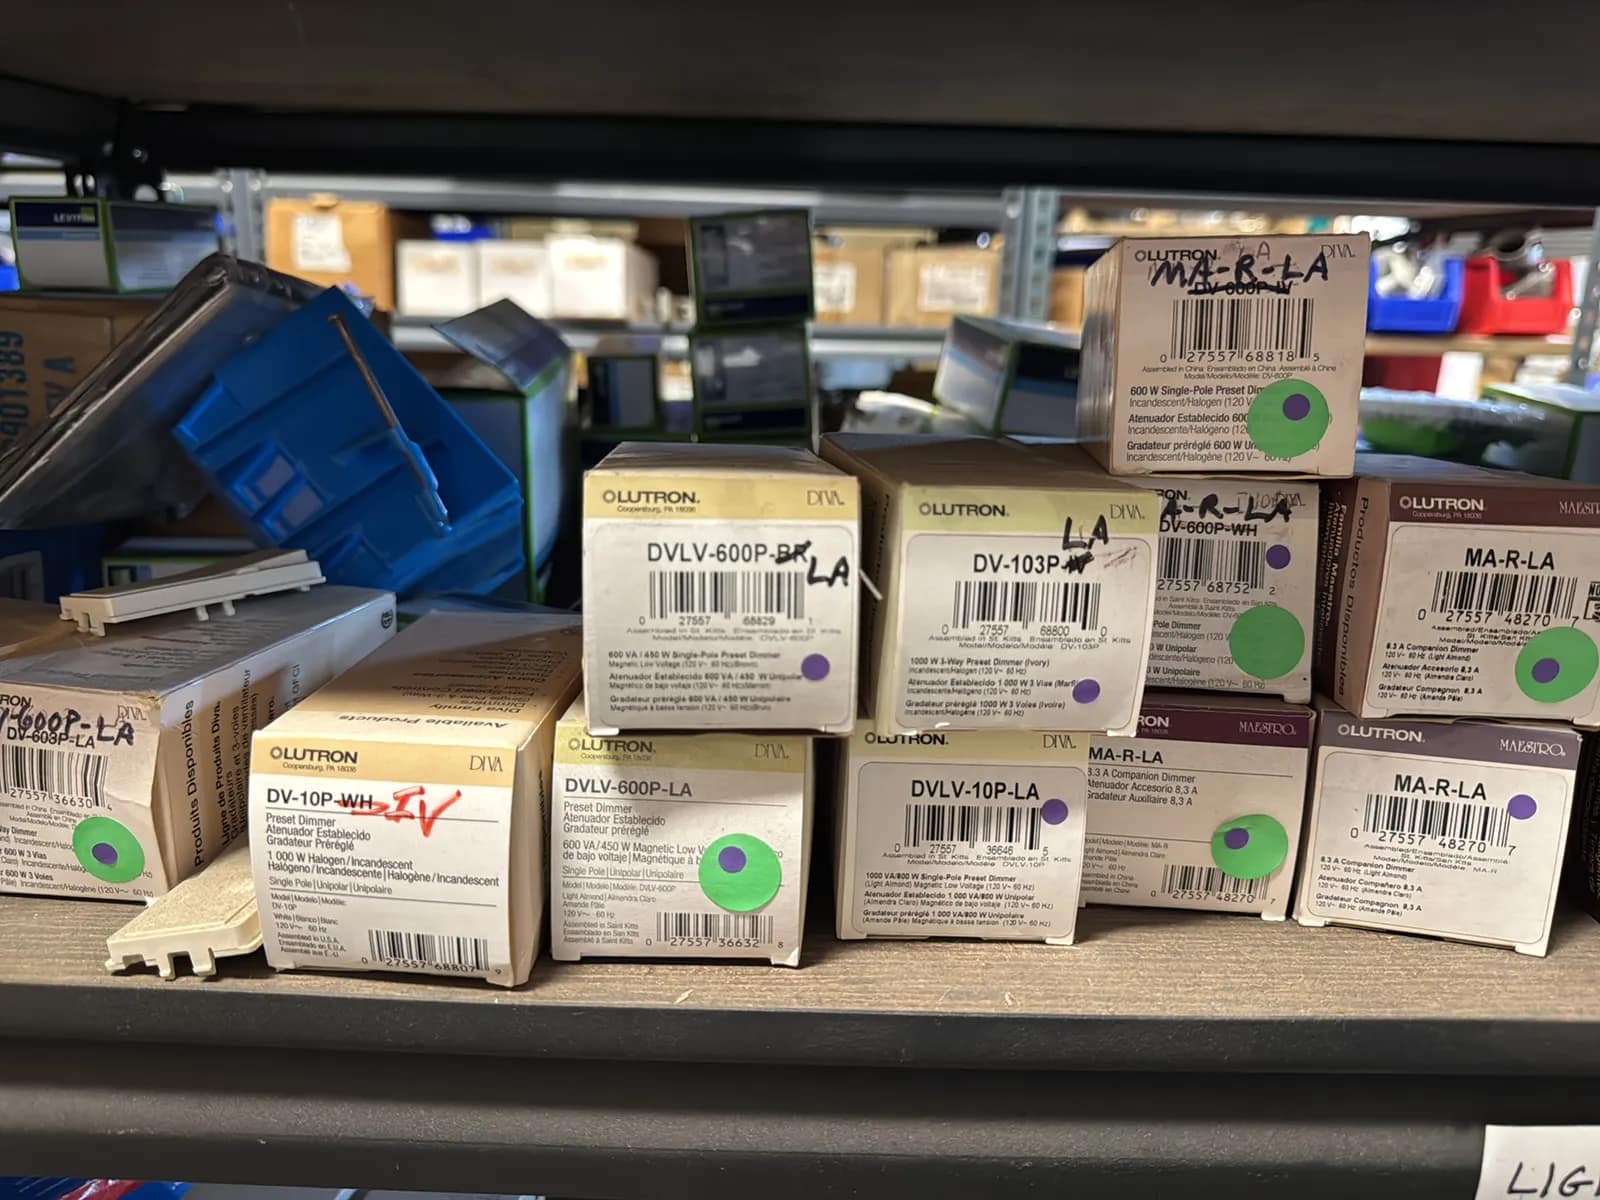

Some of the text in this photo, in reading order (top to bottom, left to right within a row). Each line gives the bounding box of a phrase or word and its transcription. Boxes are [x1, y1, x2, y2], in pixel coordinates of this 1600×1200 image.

[1160, 351, 1320, 363] 0 27557 68818 5
[1131, 386, 1244, 397] 600 W Single-Pole Preset
[1129, 413, 1229, 423] Atenuador Establecido
[1127, 441, 1170, 450] Gradateur
[1214, 441, 1231, 450] 600
[1233, 441, 1242, 450] W
[1063, 515, 1109, 550] LA
[1465, 548, 1555, 570] MA-R-LA
[808, 556, 849, 586] LA
[1158, 579, 1275, 595] 27557 68752 2
[1338, 497, 1368, 696] Productos Disponibles
[639, 617, 645, 625] 0
[680, 616, 710, 626] 27557
[1418, 609, 1426, 620] 0
[1446, 610, 1491, 623] 27557
[1505, 613, 1551, 626] 48270
[942, 625, 1107, 636] 0 27557 68800 0
[1172, 622, 1201, 630] Dimmer
[429, 719, 508, 729] Available
[1088, 747, 1163, 764] MA-R-LA
[182, 700, 204, 867] Produits Disponibles
[1112, 770, 1196, 783] Companion Dimmer
[565, 778, 692, 797] DVLV-600P-LA
[912, 780, 1039, 800] DVLV-10P-LA
[1131, 782, 1173, 793] Accesorio
[1191, 786, 1198, 794] A
[1394, 774, 1487, 800] MA-R-LA
[10, 788, 47, 801] 27557
[54, 794, 93, 809] 36630
[1128, 793, 1168, 804] Auxiliaire
[564, 801, 632, 814] Preset Dimmer
[266, 813, 335, 827] Preset Dimmer
[564, 812, 665, 826] Atenuador Establecido
[266, 826, 371, 842] Atenuador Establecido
[564, 823, 649, 836] Gradateur préréglé
[267, 837, 354, 852] Gradateur Préréglé
[563, 840, 581, 850] 600
[621, 842, 631, 852] W
[632, 843, 674, 856] Magnetic
[676, 845, 697, 855] Low
[894, 843, 1048, 856] 0 27557 36646 5
[1350, 828, 1516, 857] 0 27557 48270 7
[296, 853, 306, 863] W
[921, 873, 961, 882] Single-Pole
[1172, 890, 1209, 899] 27557
[1216, 893, 1255, 903] 48270
[670, 937, 711, 948] 27557
[718, 937, 759, 948] 36632
[386, 959, 427, 970] 27557
[435, 960, 475, 973] 68807
[1508, 1161, 1600, 1198] LIG
